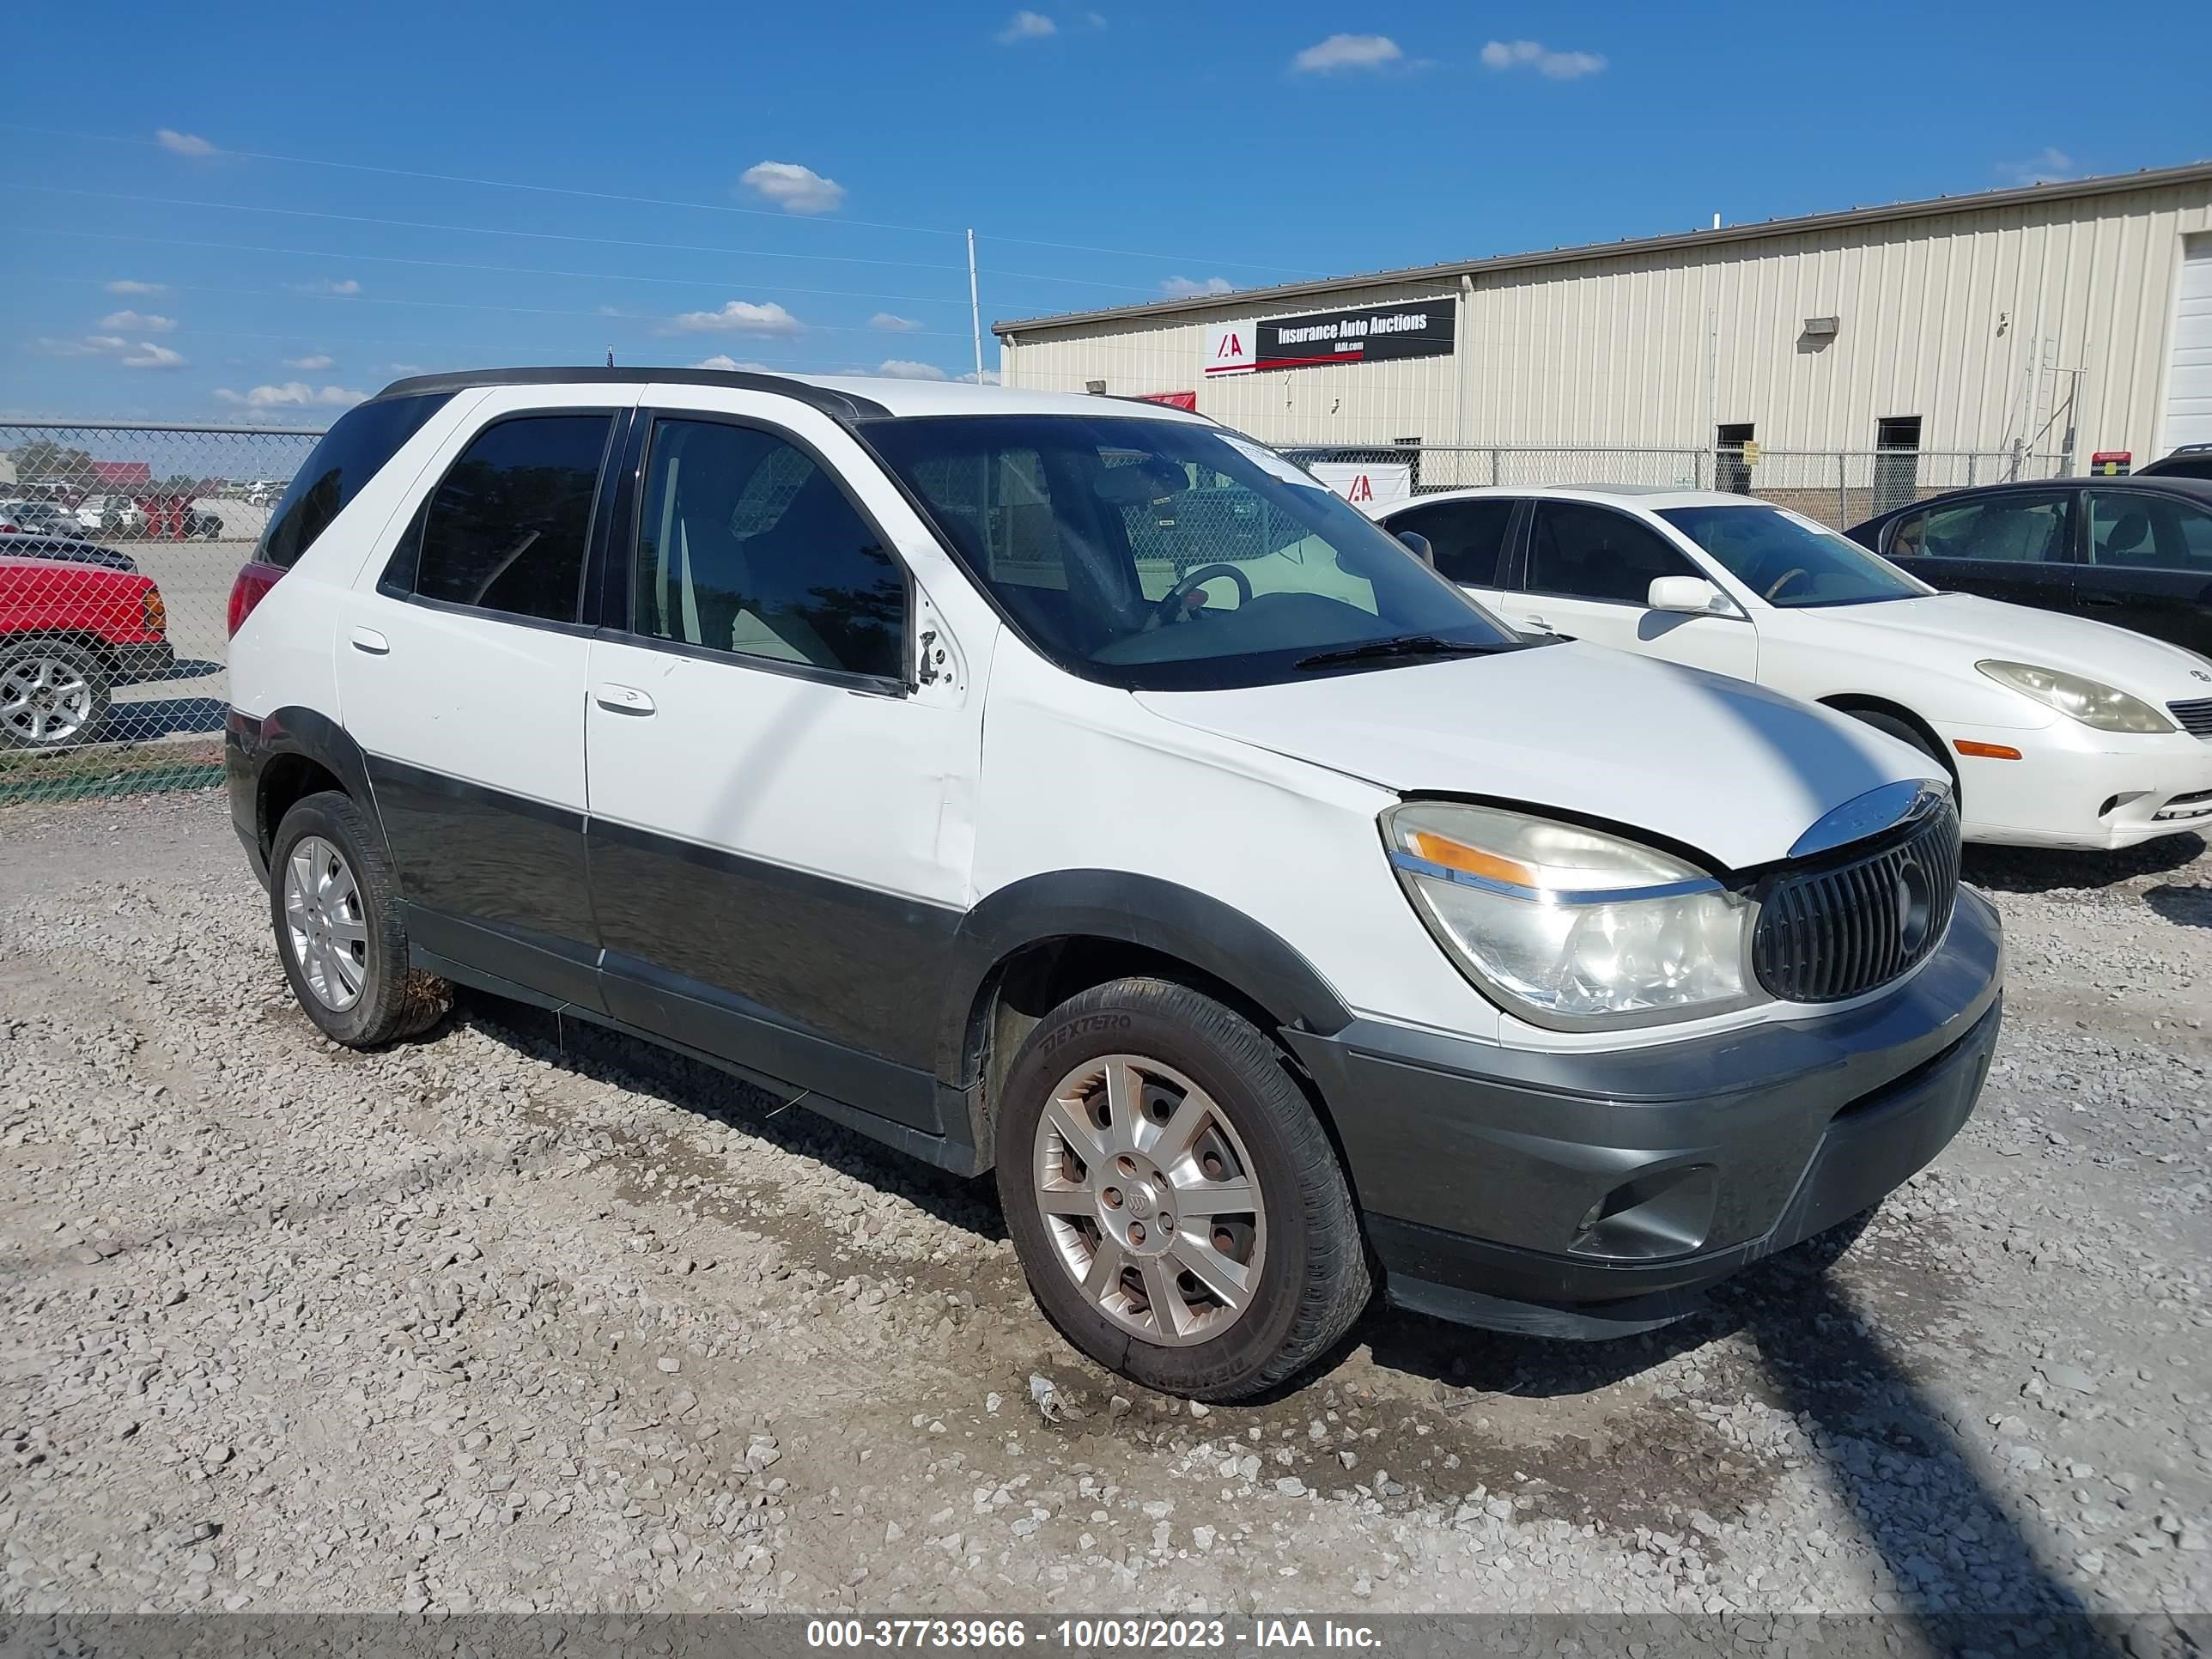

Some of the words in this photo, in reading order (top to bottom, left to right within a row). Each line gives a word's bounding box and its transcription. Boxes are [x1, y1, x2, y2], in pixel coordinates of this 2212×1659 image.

[1278, 323, 1339, 344] Insurance
[1340, 319, 1368, 338] Auto
[1370, 313, 1427, 335] Auctions
[1334, 342, 1364, 353] IAAI.com
[1038, 1014, 1132, 1057] DEXTERO
